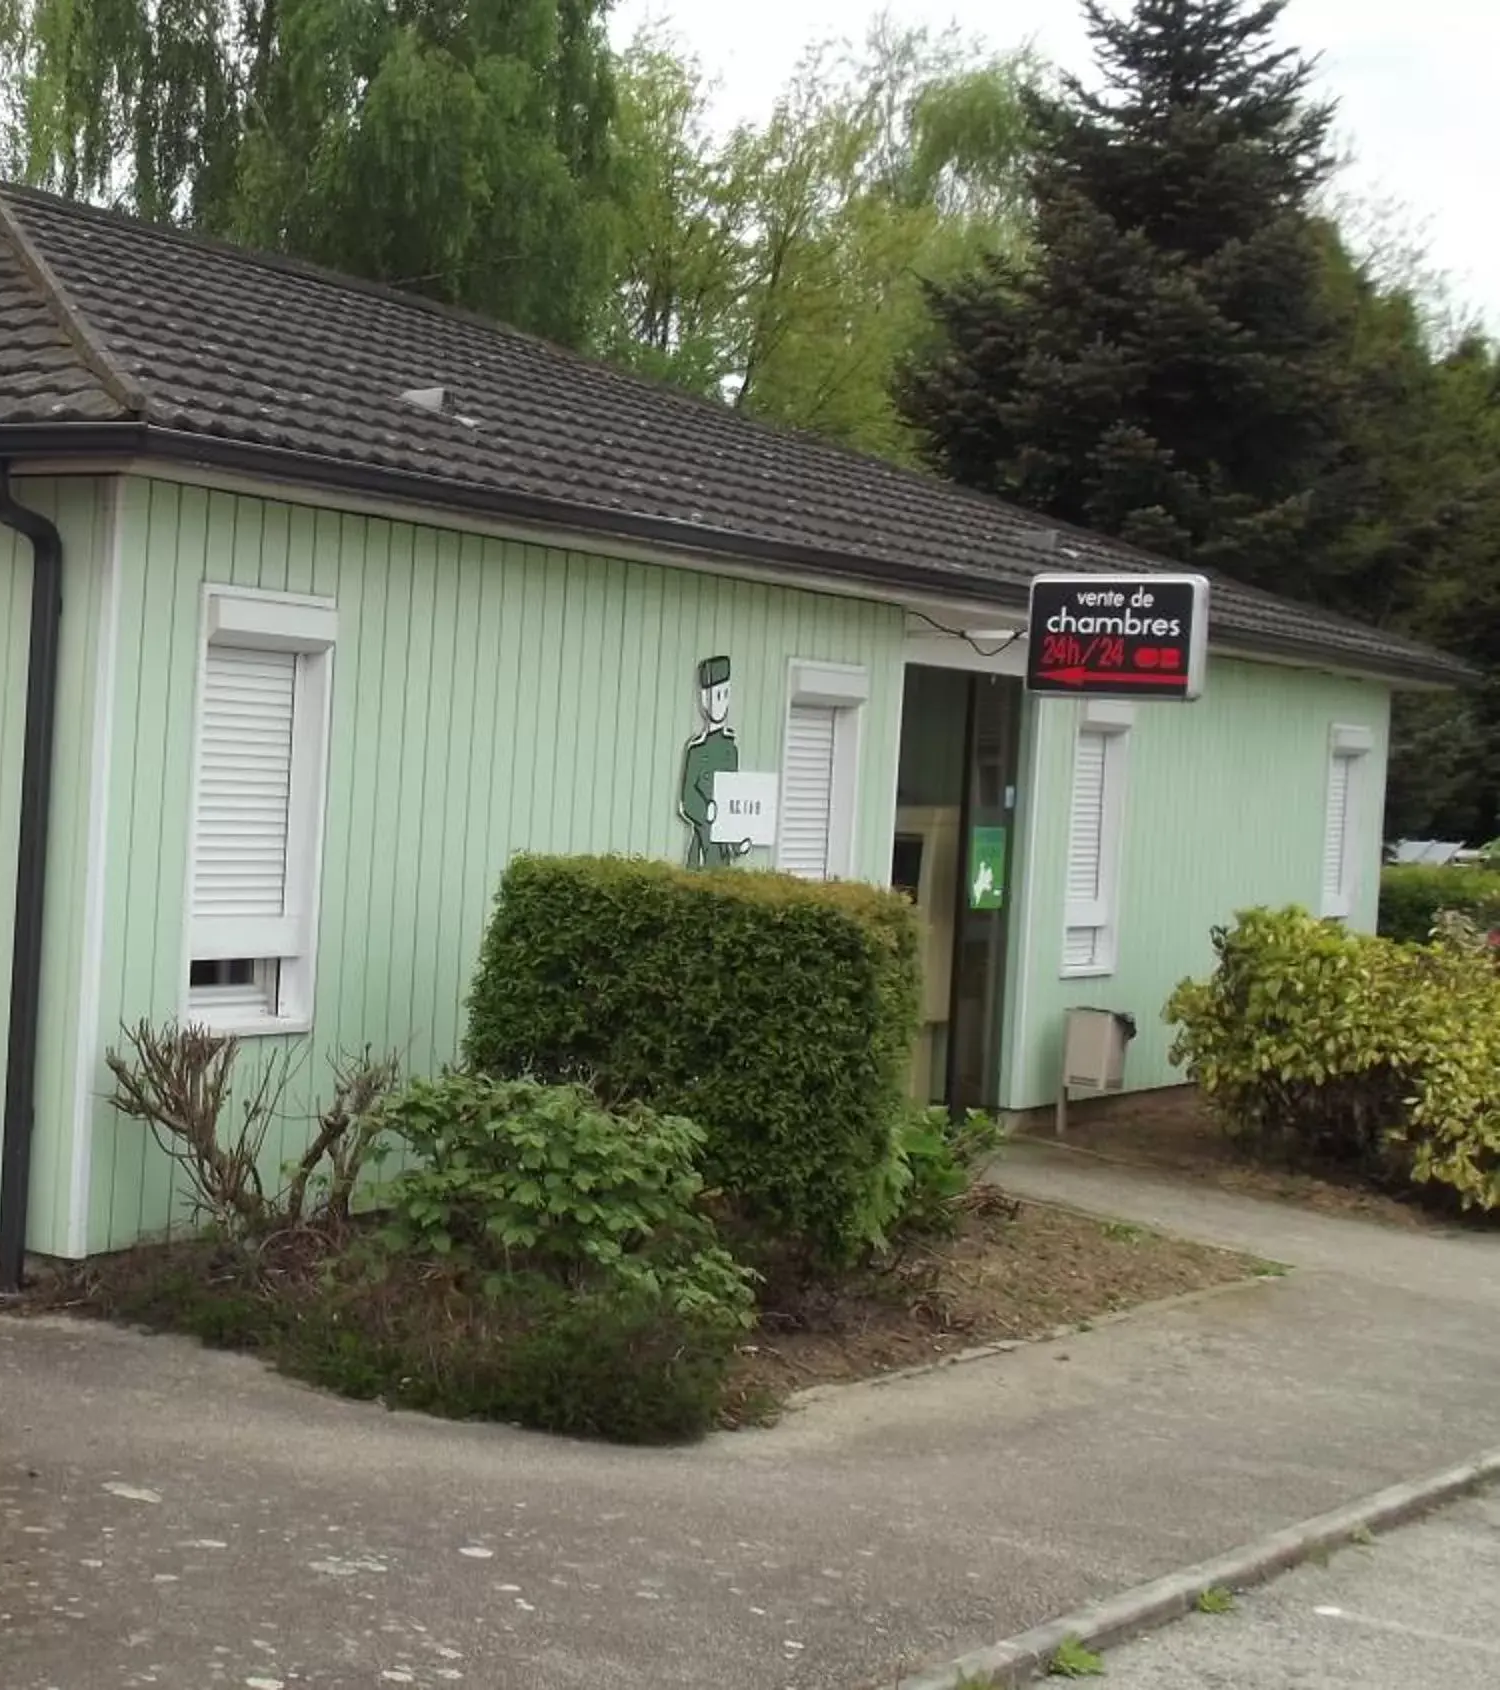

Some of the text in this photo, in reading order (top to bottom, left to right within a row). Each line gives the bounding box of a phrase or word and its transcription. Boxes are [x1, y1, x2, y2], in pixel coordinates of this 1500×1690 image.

[1077, 586, 1155, 608] vente de
[1046, 606, 1181, 637] chambres
